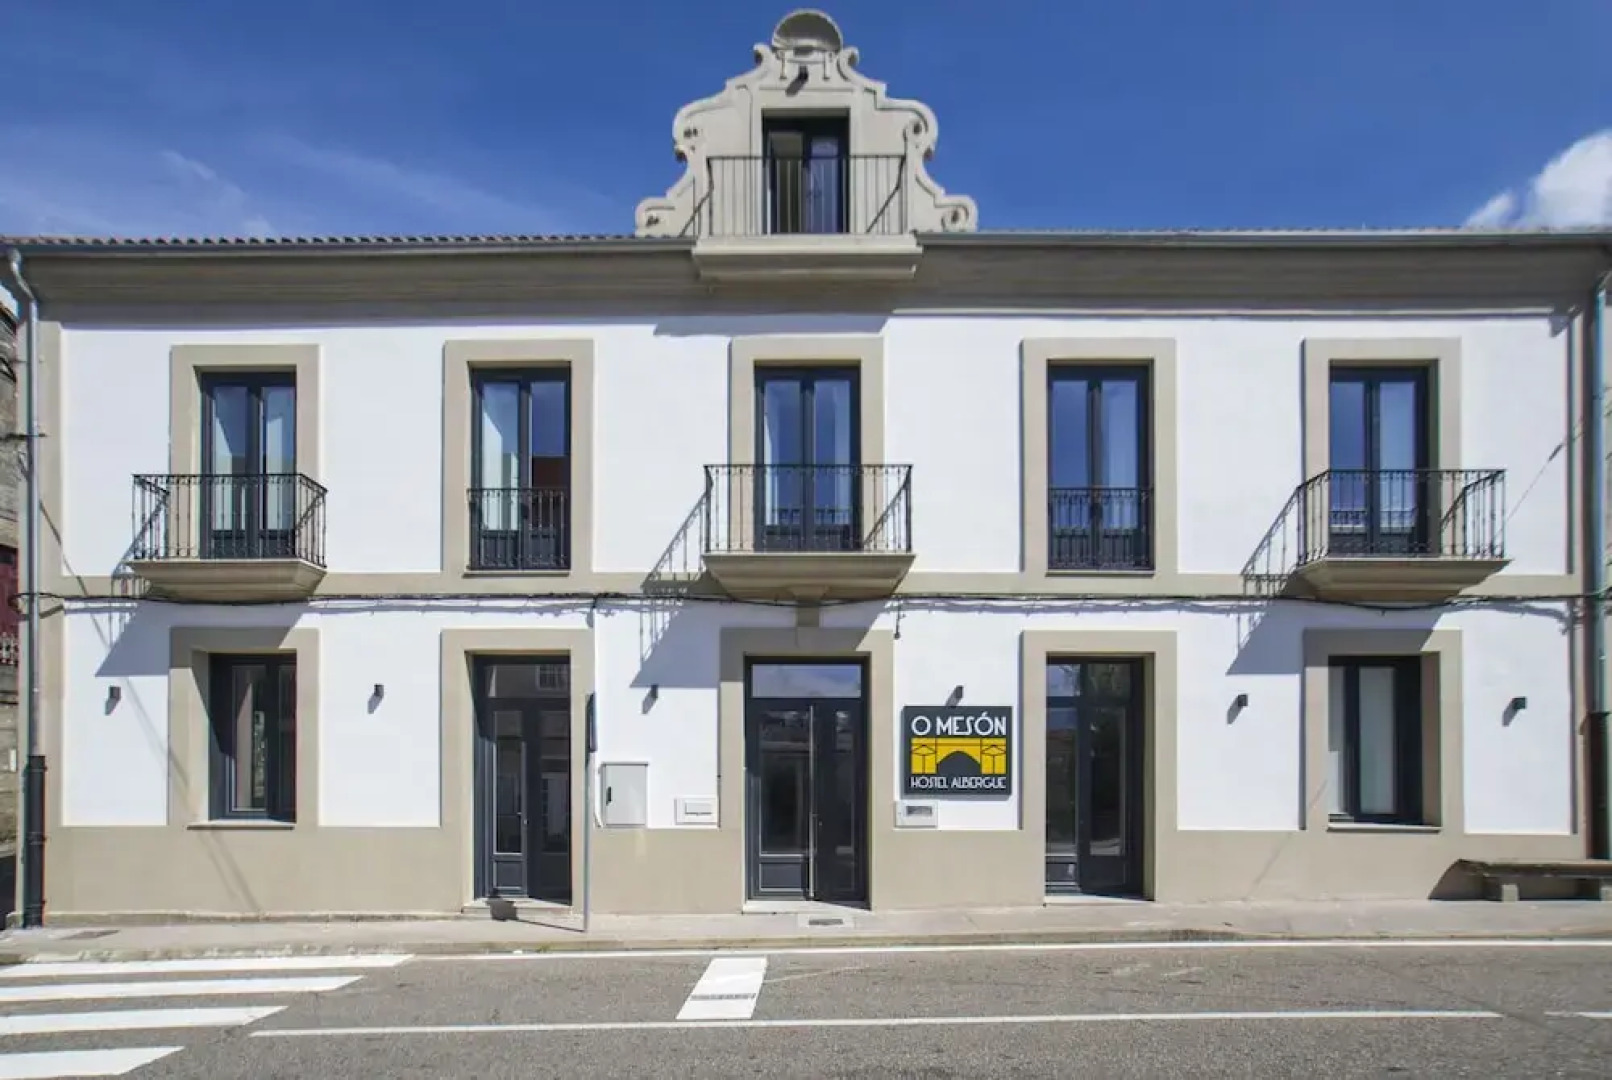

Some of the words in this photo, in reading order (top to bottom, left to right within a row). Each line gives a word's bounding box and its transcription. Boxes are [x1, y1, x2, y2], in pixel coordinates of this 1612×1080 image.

[911, 715, 932, 736] O
[936, 711, 1007, 736] MESÓN
[910, 776, 948, 789] HOSTEL
[951, 776, 1007, 789] ALBERGUE
